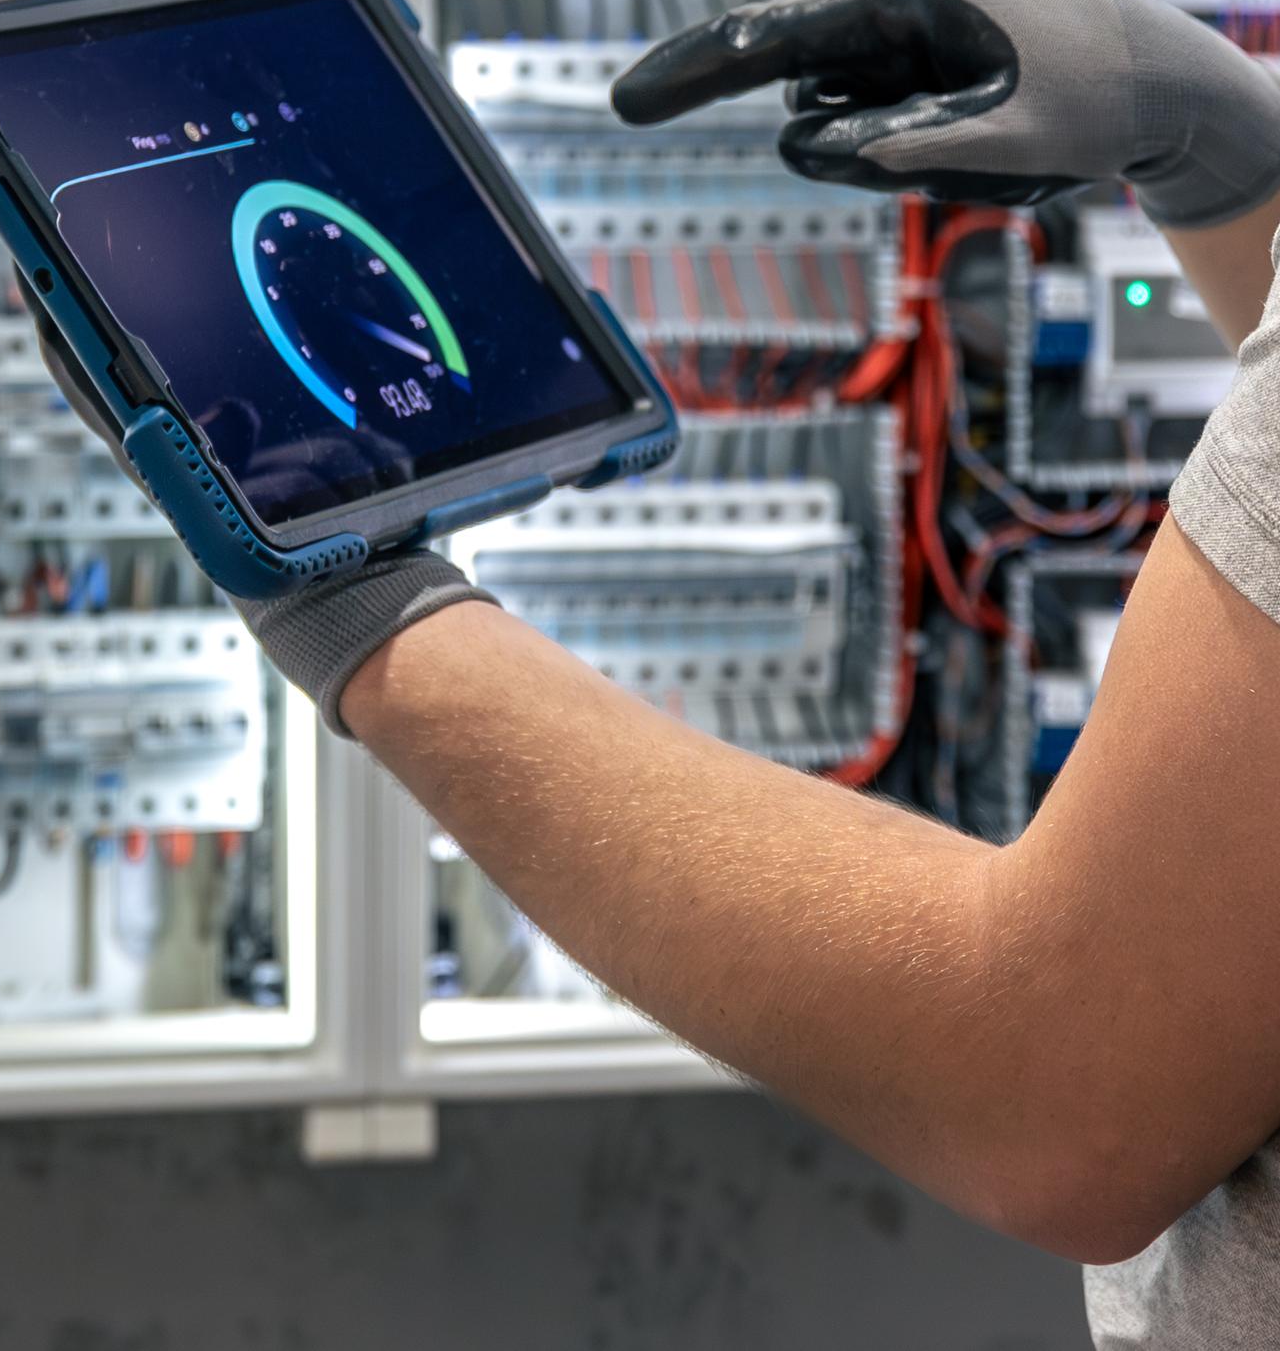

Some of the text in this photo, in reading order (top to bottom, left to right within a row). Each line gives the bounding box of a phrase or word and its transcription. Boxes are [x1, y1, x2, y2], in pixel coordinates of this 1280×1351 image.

[279, 211, 297, 227] 20
[260, 239, 277, 254] 10
[267, 286, 279, 301] 5
[409, 313, 427, 330] 75
[301, 345, 311, 359] 1
[344, 387, 357, 402] 0
[379, 378, 432, 418] 93.48
